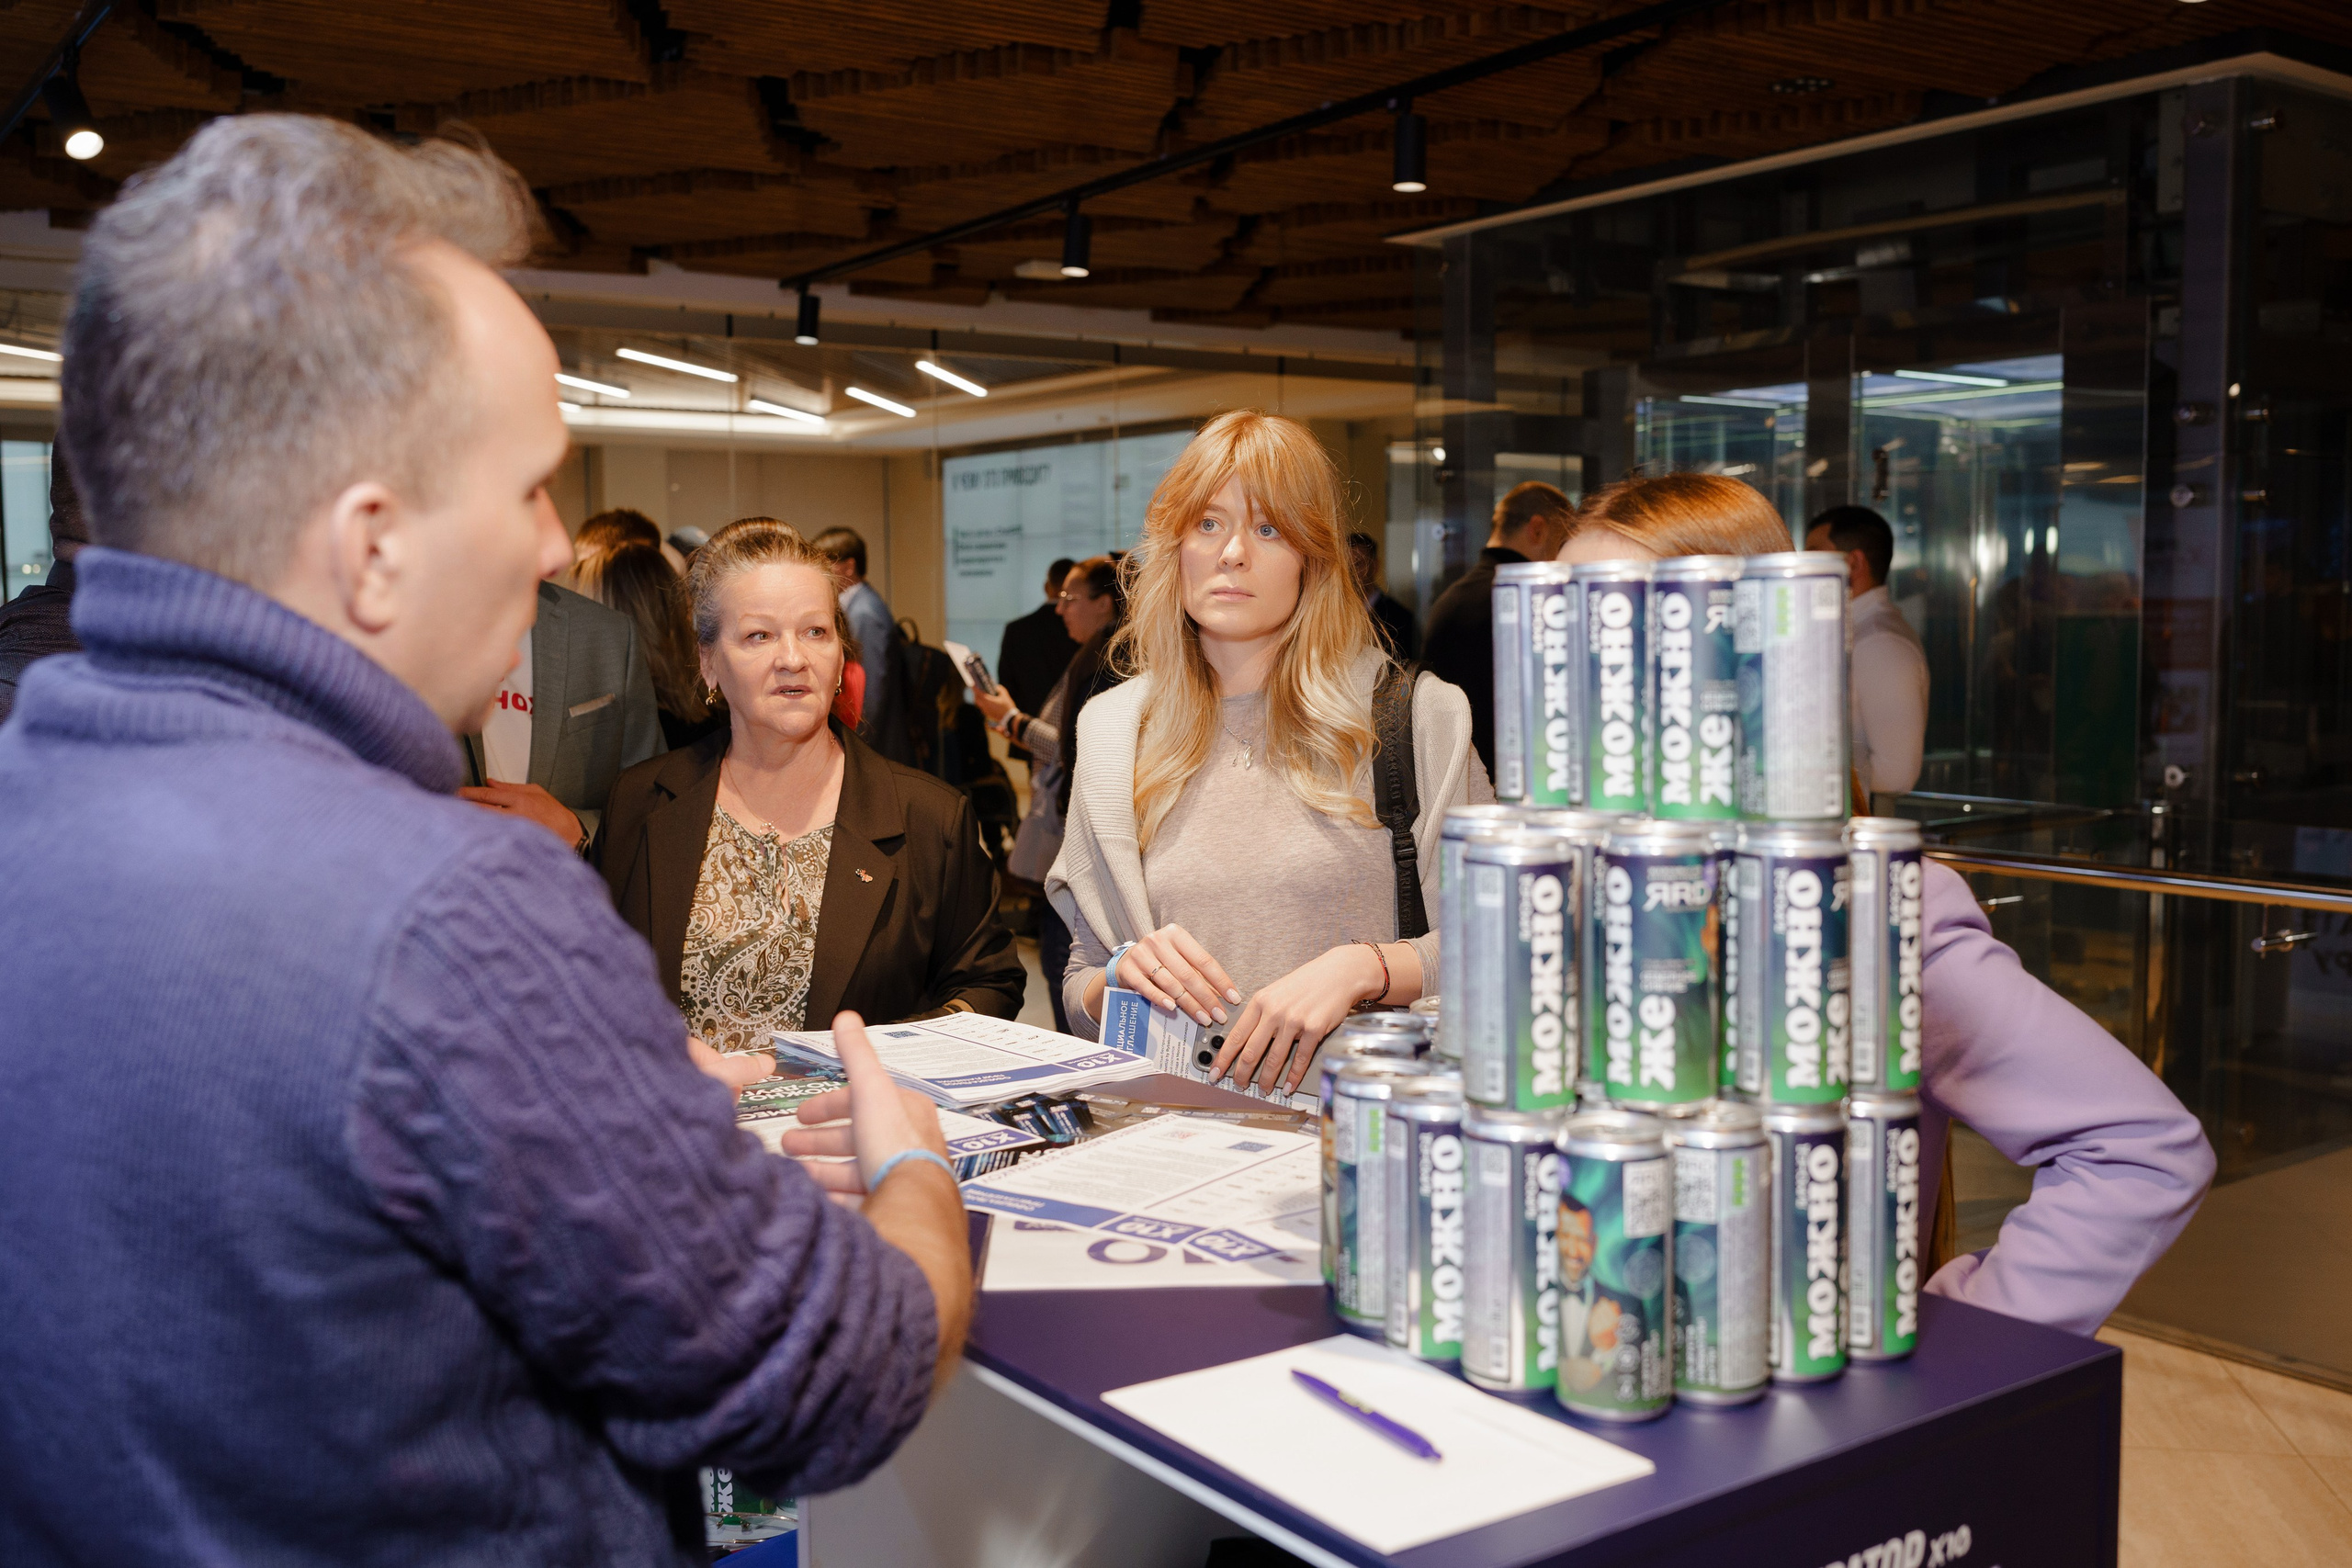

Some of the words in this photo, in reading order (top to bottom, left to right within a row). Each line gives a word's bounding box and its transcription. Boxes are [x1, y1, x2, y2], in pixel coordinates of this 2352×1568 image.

[1600, 592, 1635, 797] МОЖНО
[1660, 592, 1692, 806] МОЖНО
[1531, 874, 1563, 1098] МОЖНО
[1605, 865, 1633, 1087] МОЖНО
[1785, 869, 1822, 1090] МОЖНО
[1898, 862, 1922, 1075] МОЖНО
[1430, 1135, 1464, 1345] МОЖНО
[1807, 1144, 1838, 1361] МОЖНО
[1894, 1129, 1920, 1338] МОЖНО
